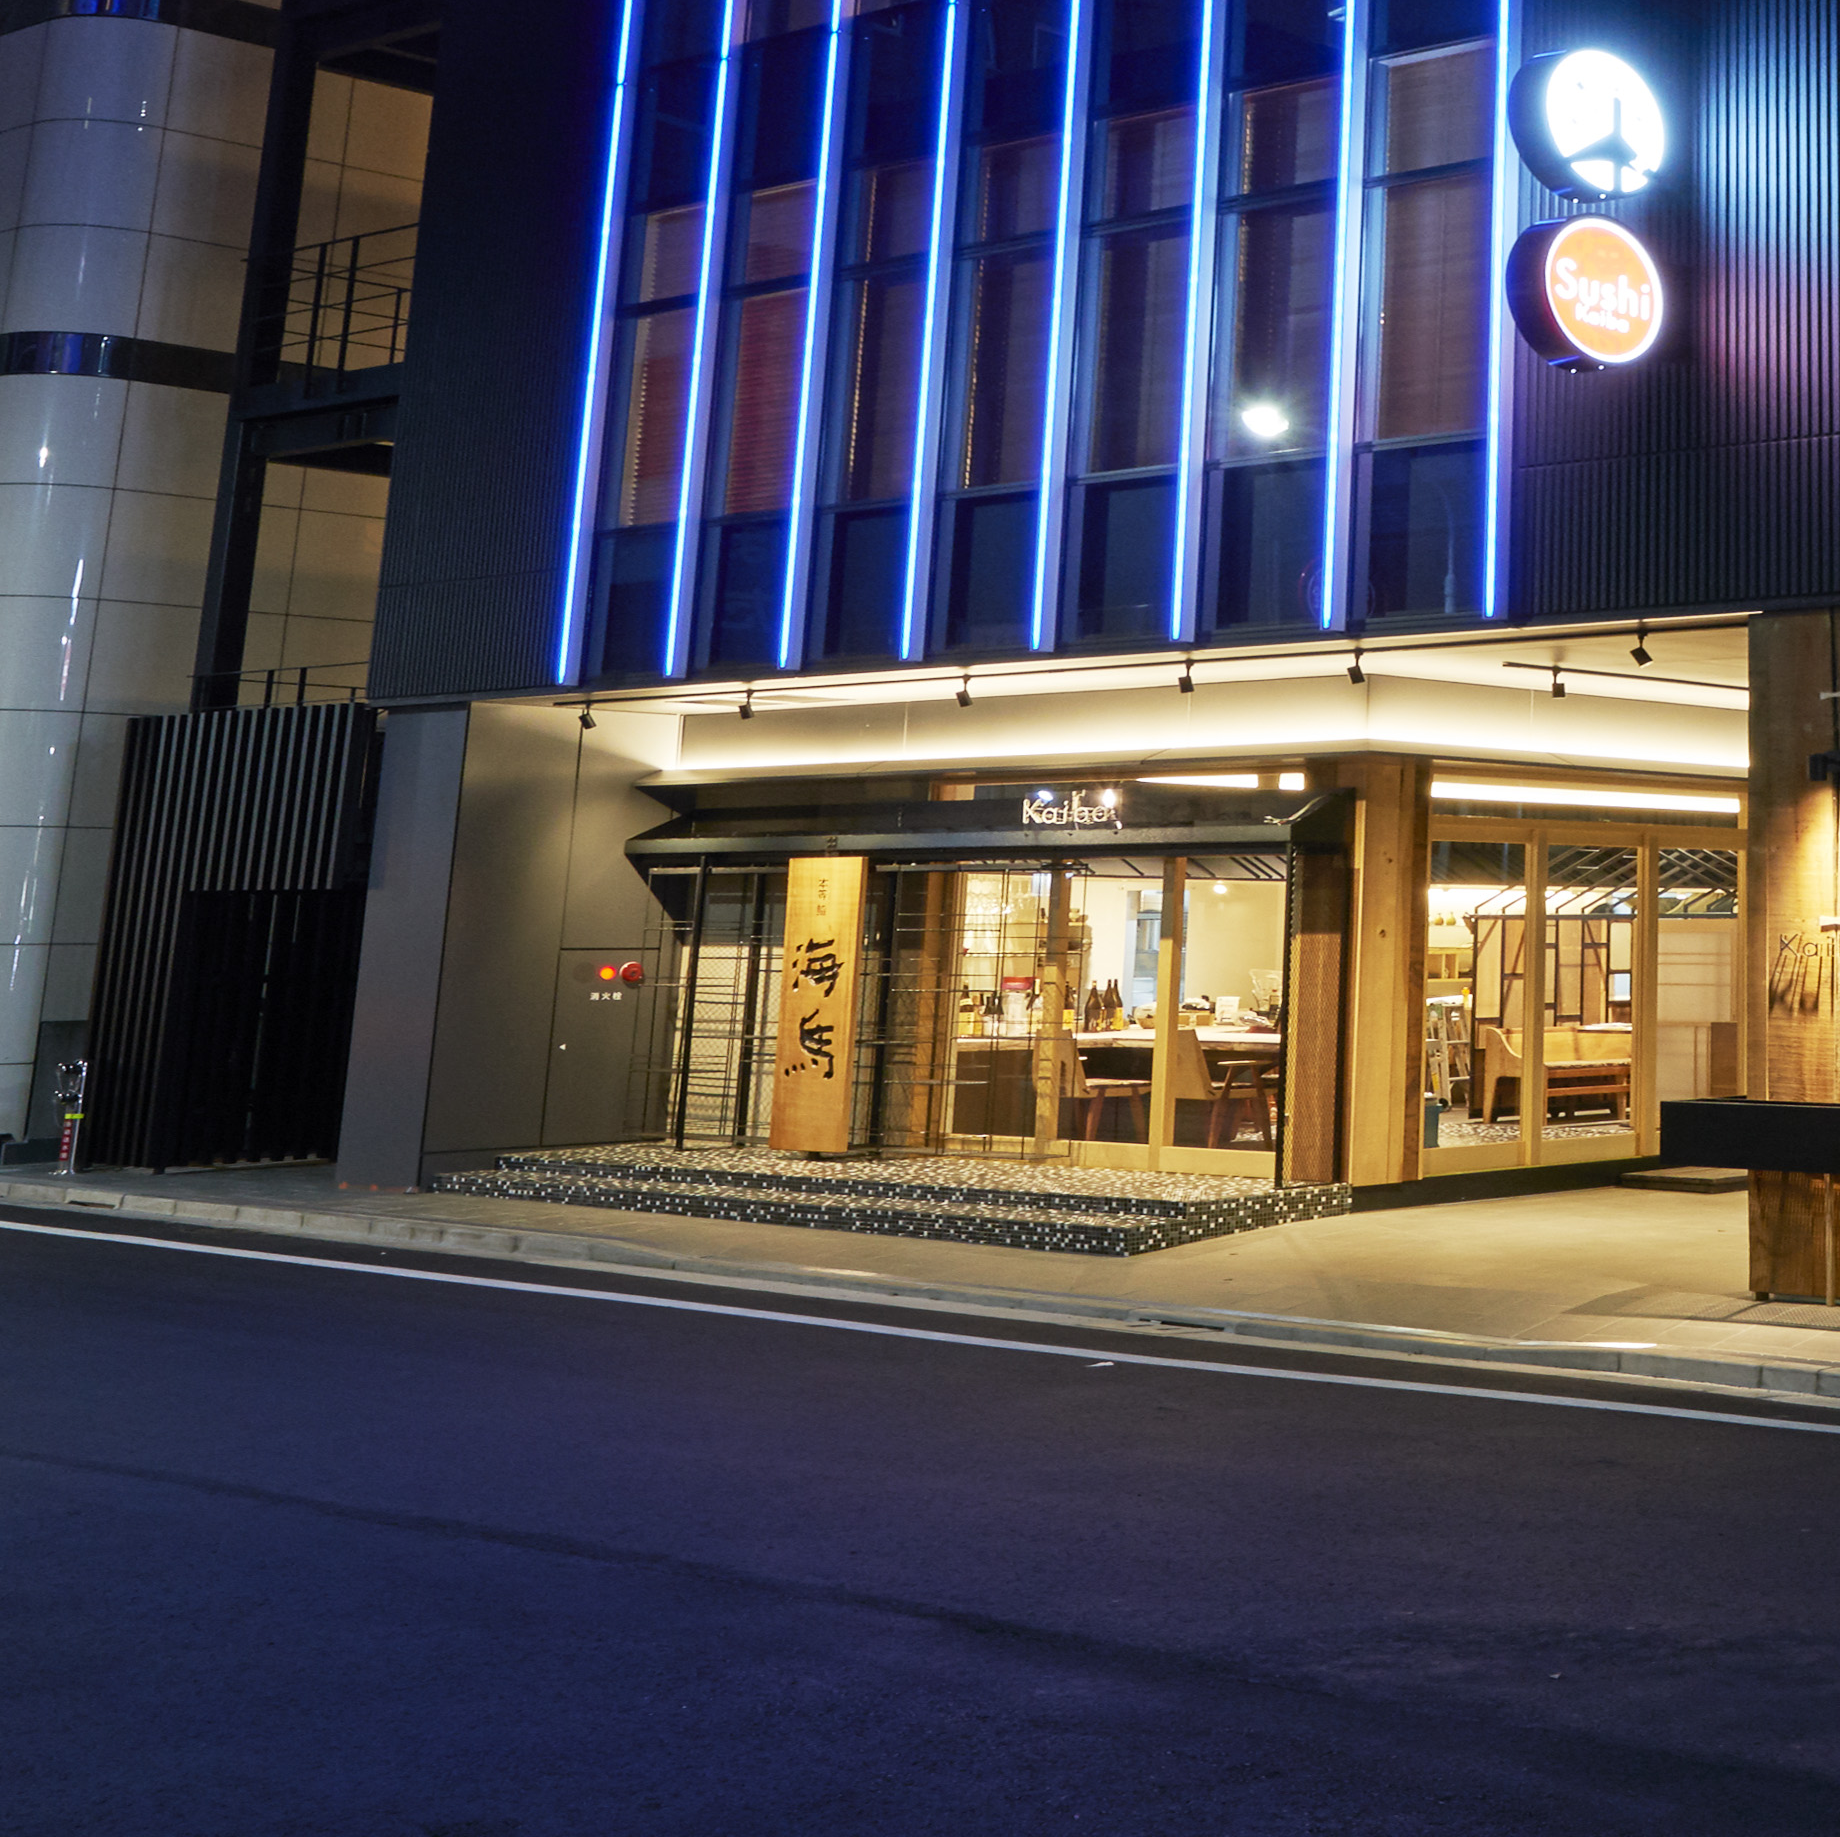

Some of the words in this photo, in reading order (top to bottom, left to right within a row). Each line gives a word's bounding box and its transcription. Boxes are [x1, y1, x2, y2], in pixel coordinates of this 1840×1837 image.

[1555, 257, 1651, 321] Sushi
[1022, 791, 1109, 824] Kaiba
[784, 938, 845, 1080] 海馬
